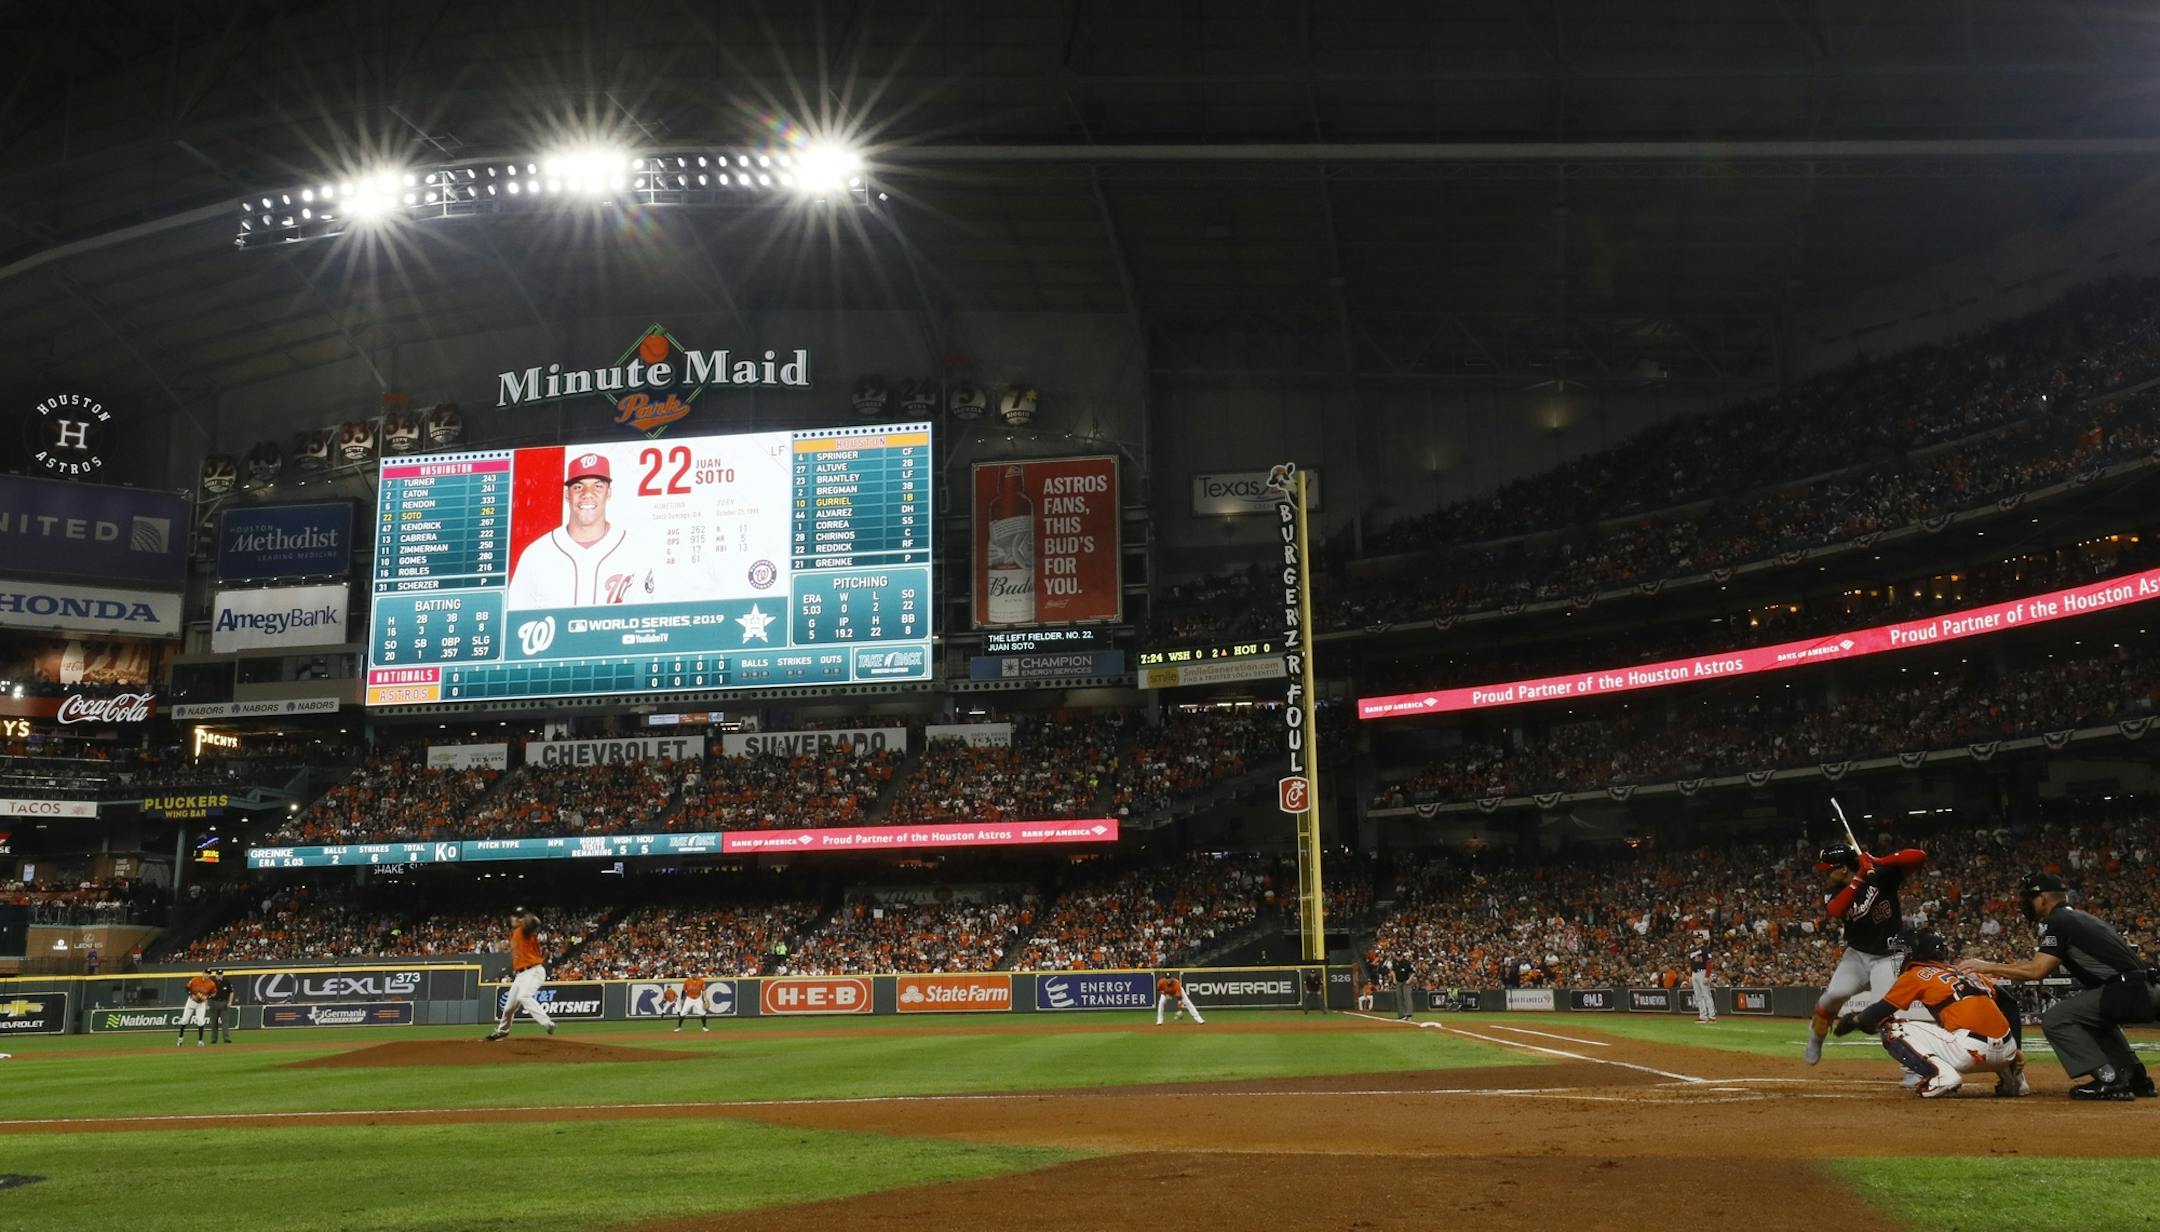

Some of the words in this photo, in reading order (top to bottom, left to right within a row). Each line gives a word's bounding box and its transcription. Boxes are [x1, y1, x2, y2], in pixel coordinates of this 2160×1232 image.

[496, 358, 672, 407] Minute
[682, 349, 810, 387] Maid
[36, 394, 111, 423] HOUSTON
[614, 392, 691, 431] Park
[56, 419, 90, 449] H
[816, 451, 859, 461] SPRINGER
[35, 450, 102, 474] ASTROS
[696, 459, 721, 468] JUAN
[816, 463, 847, 472] ALTUVE
[420, 464, 473, 475] WASHINGTON
[638, 446, 691, 496] 22
[695, 468, 735, 485] SOTO
[816, 474, 860, 484] BRANTLEY
[403, 478, 435, 487] TURNER
[1043, 475, 1107, 495] ASTROS
[1199, 477, 1259, 498] Texas
[403, 489, 429, 498] EATON
[816, 485, 857, 495] BREGMAN
[402, 500, 435, 509] RENDON
[816, 497, 852, 507] GURRIEL
[1043, 496, 1090, 515] FANS,
[401, 512, 422, 520] SOTO
[816, 508, 852, 518] ALVAREZ
[401, 522, 441, 531] KENDRICK
[816, 520, 849, 529] CORREA
[1044, 517, 1081, 534] THIS
[229, 526, 339, 552] Methodist
[400, 533, 437, 542] CABRERA
[816, 531, 856, 541] CHIRINOS
[400, 544, 448, 554] ZIMMERMAN
[816, 543, 852, 552] REDDICK
[1044, 536, 1095, 554] BUD'S
[399, 556, 427, 565] GOMES
[815, 558, 852, 567] GREINKE
[398, 567, 430, 576] ROBLES
[1045, 558, 1077, 575] FOR
[397, 580, 439, 590] SCHERZER
[833, 576, 888, 589] PITCHING
[1045, 577, 1083, 595] YOU.
[803, 594, 822, 604] ERA
[415, 599, 461, 612] BATTING
[803, 605, 822, 615] 5.03
[1890, 626, 1938, 646] Proud
[1943, 613, 2001, 637] Partner
[2006, 604, 2024, 623] of
[2029, 597, 2058, 617] the
[2064, 585, 2133, 612] Houston
[2139, 577, 2160, 596] As
[216, 605, 337, 634] AmegyBank
[588, 618, 640, 631] WORLD
[641, 615, 690, 629] SERIES
[692, 614, 725, 625] 2019
[835, 628, 853, 638] 19.2
[988, 634, 1006, 642] THE
[1006, 634, 1027, 642] LEFT
[1066, 632, 1081, 641] NO.
[441, 637, 460, 647] OBP
[472, 636, 490, 645] SLG
[440, 648, 458, 658] .357
[471, 646, 489, 656] .557
[988, 643, 1010, 652] JUAN
[1807, 645, 1840, 657] AMERICA
[1140, 653, 1163, 664] 7:24
[1168, 650, 1191, 662] WSH
[1233, 644, 1257, 656] HOU
[741, 659, 769, 668] BALLS
[777, 657, 812, 666] STRIKES
[820, 656, 842, 664] OUTS
[1021, 656, 1092, 668] CHAMPION
[376, 669, 433, 683] NATIONALS
[1021, 668, 1053, 677] ENERGY
[1054, 667, 1092, 675] SERVICES
[1149, 671, 1177, 683] smile
[1472, 690, 1513, 705] Proud
[1518, 681, 1572, 700] Partner
[1577, 677, 1593, 692] of
[1598, 674, 1623, 690] the
[1628, 666, 1689, 687] Houston
[1694, 658, 1743, 676] Astros
[380, 688, 429, 700] ASTROS
[188, 706, 224, 715] NABORS
[243, 704, 279, 712] NABORS
[298, 702, 335, 710] NABORS
[1365, 705, 1383, 713] BANK
[1393, 702, 1423, 710] AMERICA
[541, 740, 688, 766] CHEVROLET
[144, 794, 229, 812] PLUCKERS
[165, 809, 190, 818] WING
[191, 808, 207, 817] BAR
[613, 836, 632, 844] WSH
[636, 835, 654, 843] HOU
[823, 835, 851, 845] Proud
[856, 834, 892, 845] Partner
[896, 832, 908, 842] of
[911, 832, 928, 842] the
[932, 831, 974, 842] Houston
[978, 830, 1012, 840] Astros
[359, 845, 390, 853] STRIKES
[478, 841, 500, 849] PITCH
[502, 840, 520, 848] TYPE
[250, 849, 294, 858] GREINKE
[572, 849, 612, 857] REMAINING
[258, 858, 275, 867] ERA
[284, 857, 304, 867] 5.03
[395, 972, 421, 983] 373
[1330, 974, 1351, 983] 326
[1080, 981, 1133, 993] ENERGY
[1187, 981, 1295, 996] POWERADE
[631, 983, 732, 1015] RC
[1080, 994, 1146, 1006] TRANSFER
[1582, 993, 1603, 1008] @MLB
[522, 1000, 600, 1014] ORTSNET
[324, 1009, 367, 1018] Germania
[119, 1014, 168, 1027] National
